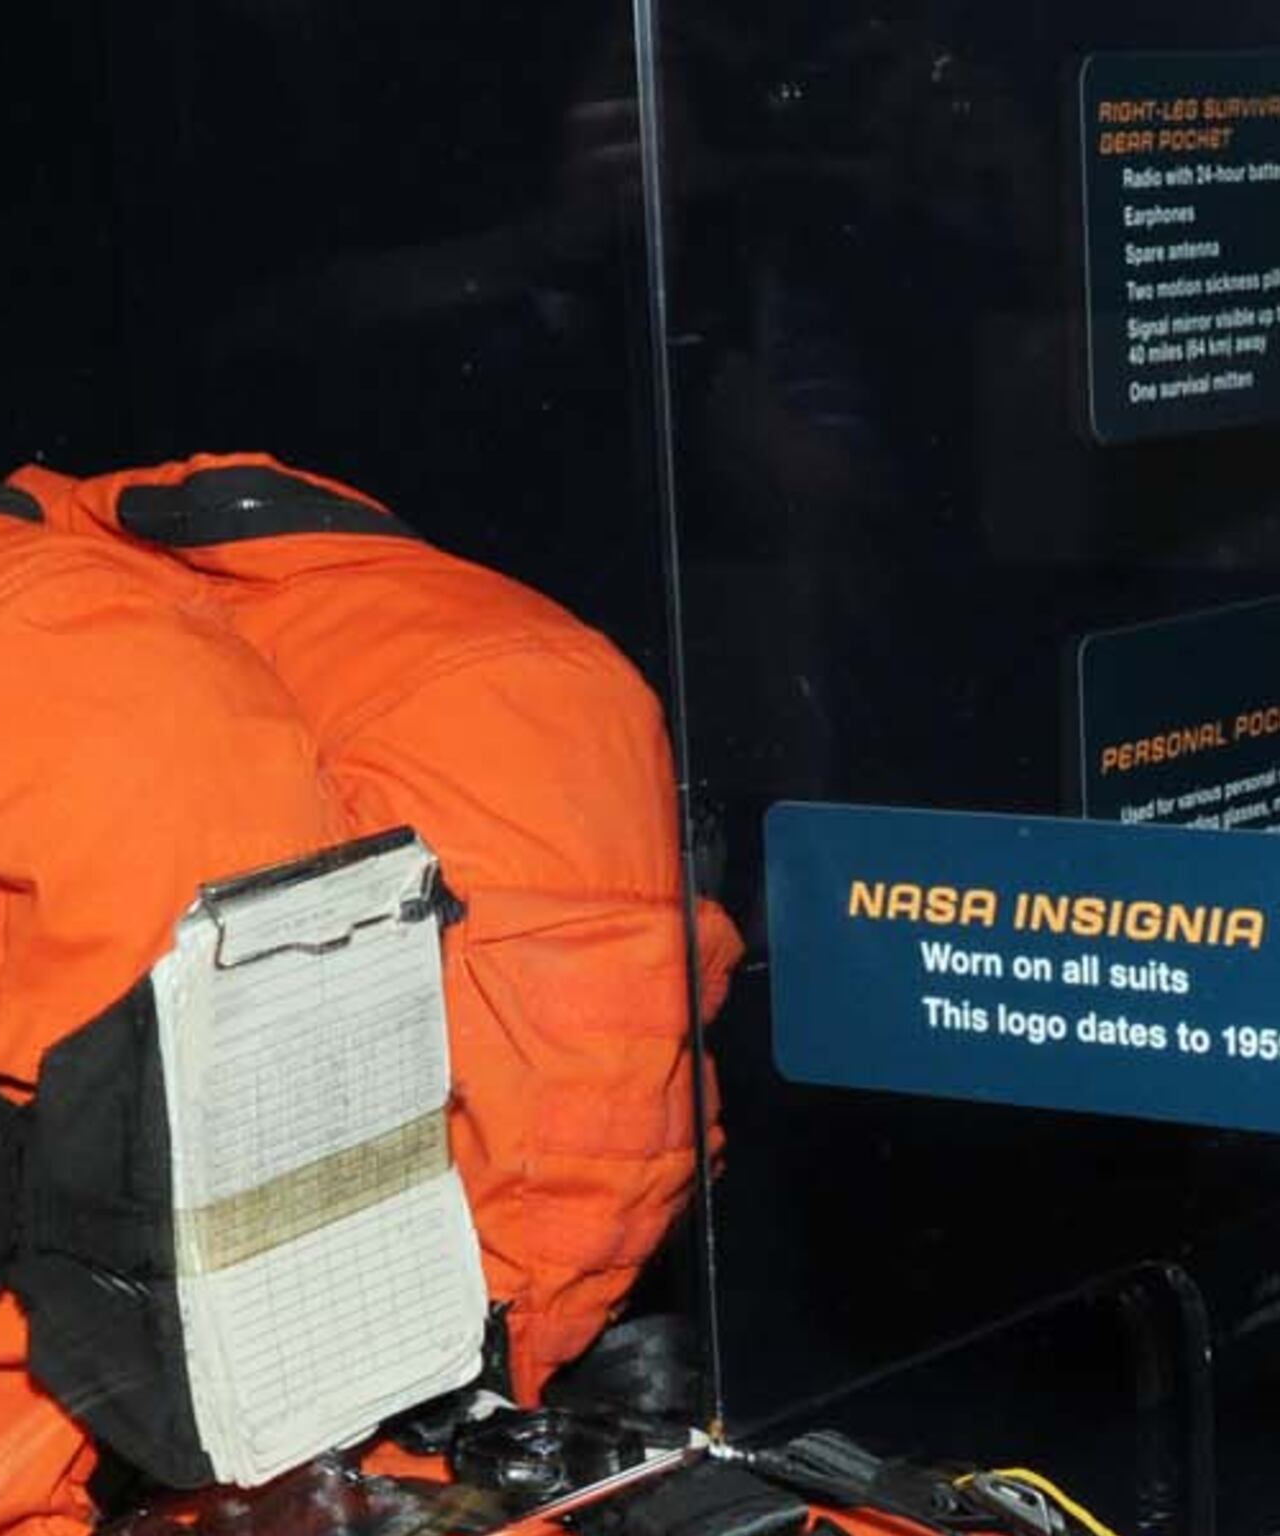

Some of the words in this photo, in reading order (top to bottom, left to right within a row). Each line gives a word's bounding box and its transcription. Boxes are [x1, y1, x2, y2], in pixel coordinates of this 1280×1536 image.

[1098, 99, 1198, 123] RIGHT-LEG
[1099, 131, 1154, 155] GEAR
[1159, 127, 1233, 150] POCKET
[1123, 166, 1162, 188] Radio
[1166, 164, 1193, 186] with
[1197, 163, 1246, 184] 24-hour
[1124, 205, 1195, 229] Earphones
[1126, 243, 1164, 265] Spare
[1168, 239, 1220, 260] antenna
[1127, 281, 1153, 301] Two
[1157, 277, 1201, 298] motion
[1205, 271, 1259, 293] sickness
[1128, 317, 1170, 340] Signal
[1173, 312, 1212, 334] mirror
[1216, 308, 1255, 329] visible
[1258, 307, 1273, 328] up
[1129, 345, 1145, 365] 40
[1148, 341, 1183, 362] miles
[1186, 338, 1206, 360] (64
[1208, 335, 1232, 358] km)
[1235, 334, 1267, 354] away
[1130, 381, 1157, 403] One
[1159, 372, 1210, 398] survival
[1213, 371, 1253, 392] mitten
[1101, 721, 1229, 774] PERSONAL
[1157, 799, 1176, 815] for
[1177, 785, 1222, 811] various
[1224, 769, 1276, 800] personal
[848, 881, 997, 927] NASA
[1014, 893, 1264, 949] INSIGNIA
[920, 941, 1003, 978] Worn
[1012, 955, 1053, 982] on
[1061, 954, 1100, 986] all
[1109, 960, 1190, 994] suits
[921, 996, 990, 1033] This
[997, 1003, 1067, 1045] logo
[1076, 1011, 1168, 1050] dates
[1176, 1022, 1211, 1054] to
